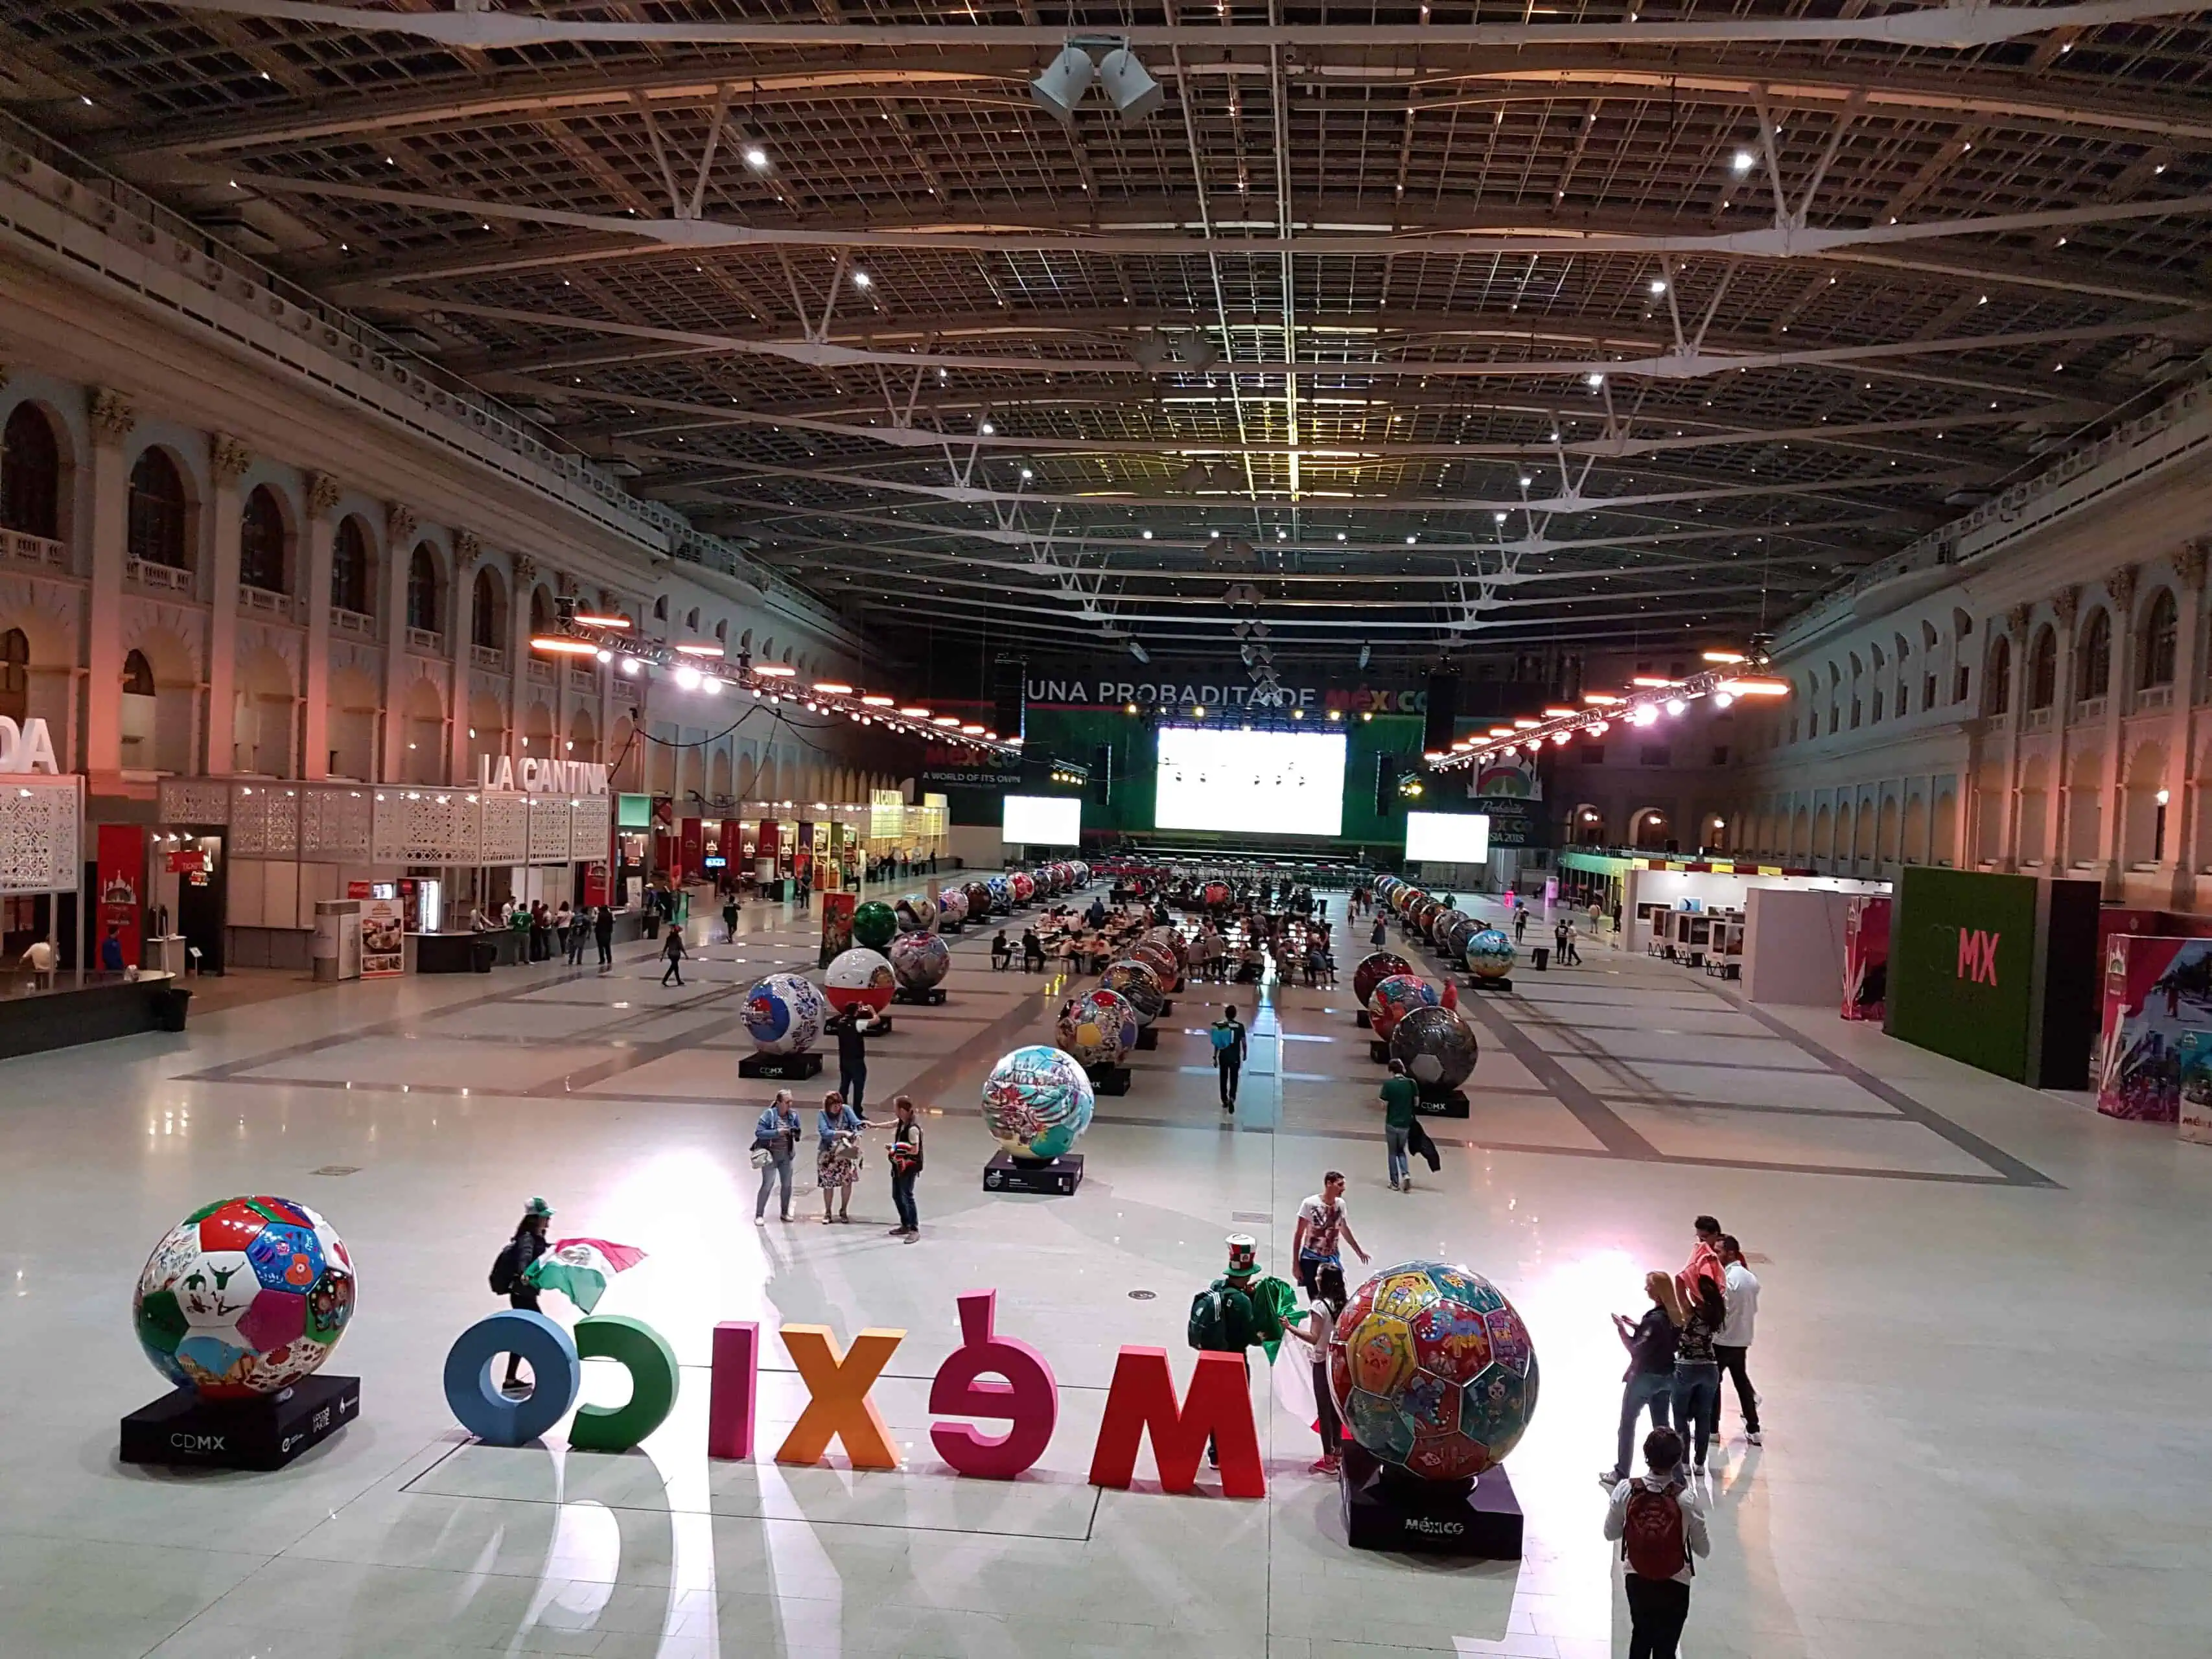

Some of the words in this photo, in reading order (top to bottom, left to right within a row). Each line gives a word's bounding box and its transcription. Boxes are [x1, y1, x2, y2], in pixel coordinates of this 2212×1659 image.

[1028, 680, 1088, 702] UNA
[1099, 682, 1264, 706] PROBADITA
[478, 752, 515, 791] LA
[518, 758, 609, 795] CANTINA
[931, 772, 965, 781] WORLD
[966, 773, 981, 782] OF
[981, 774, 995, 783] ITS
[997, 775, 1021, 783] OWN
[1421, 1102, 1447, 1110] CDMX
[170, 1433, 226, 1450] CDMX
